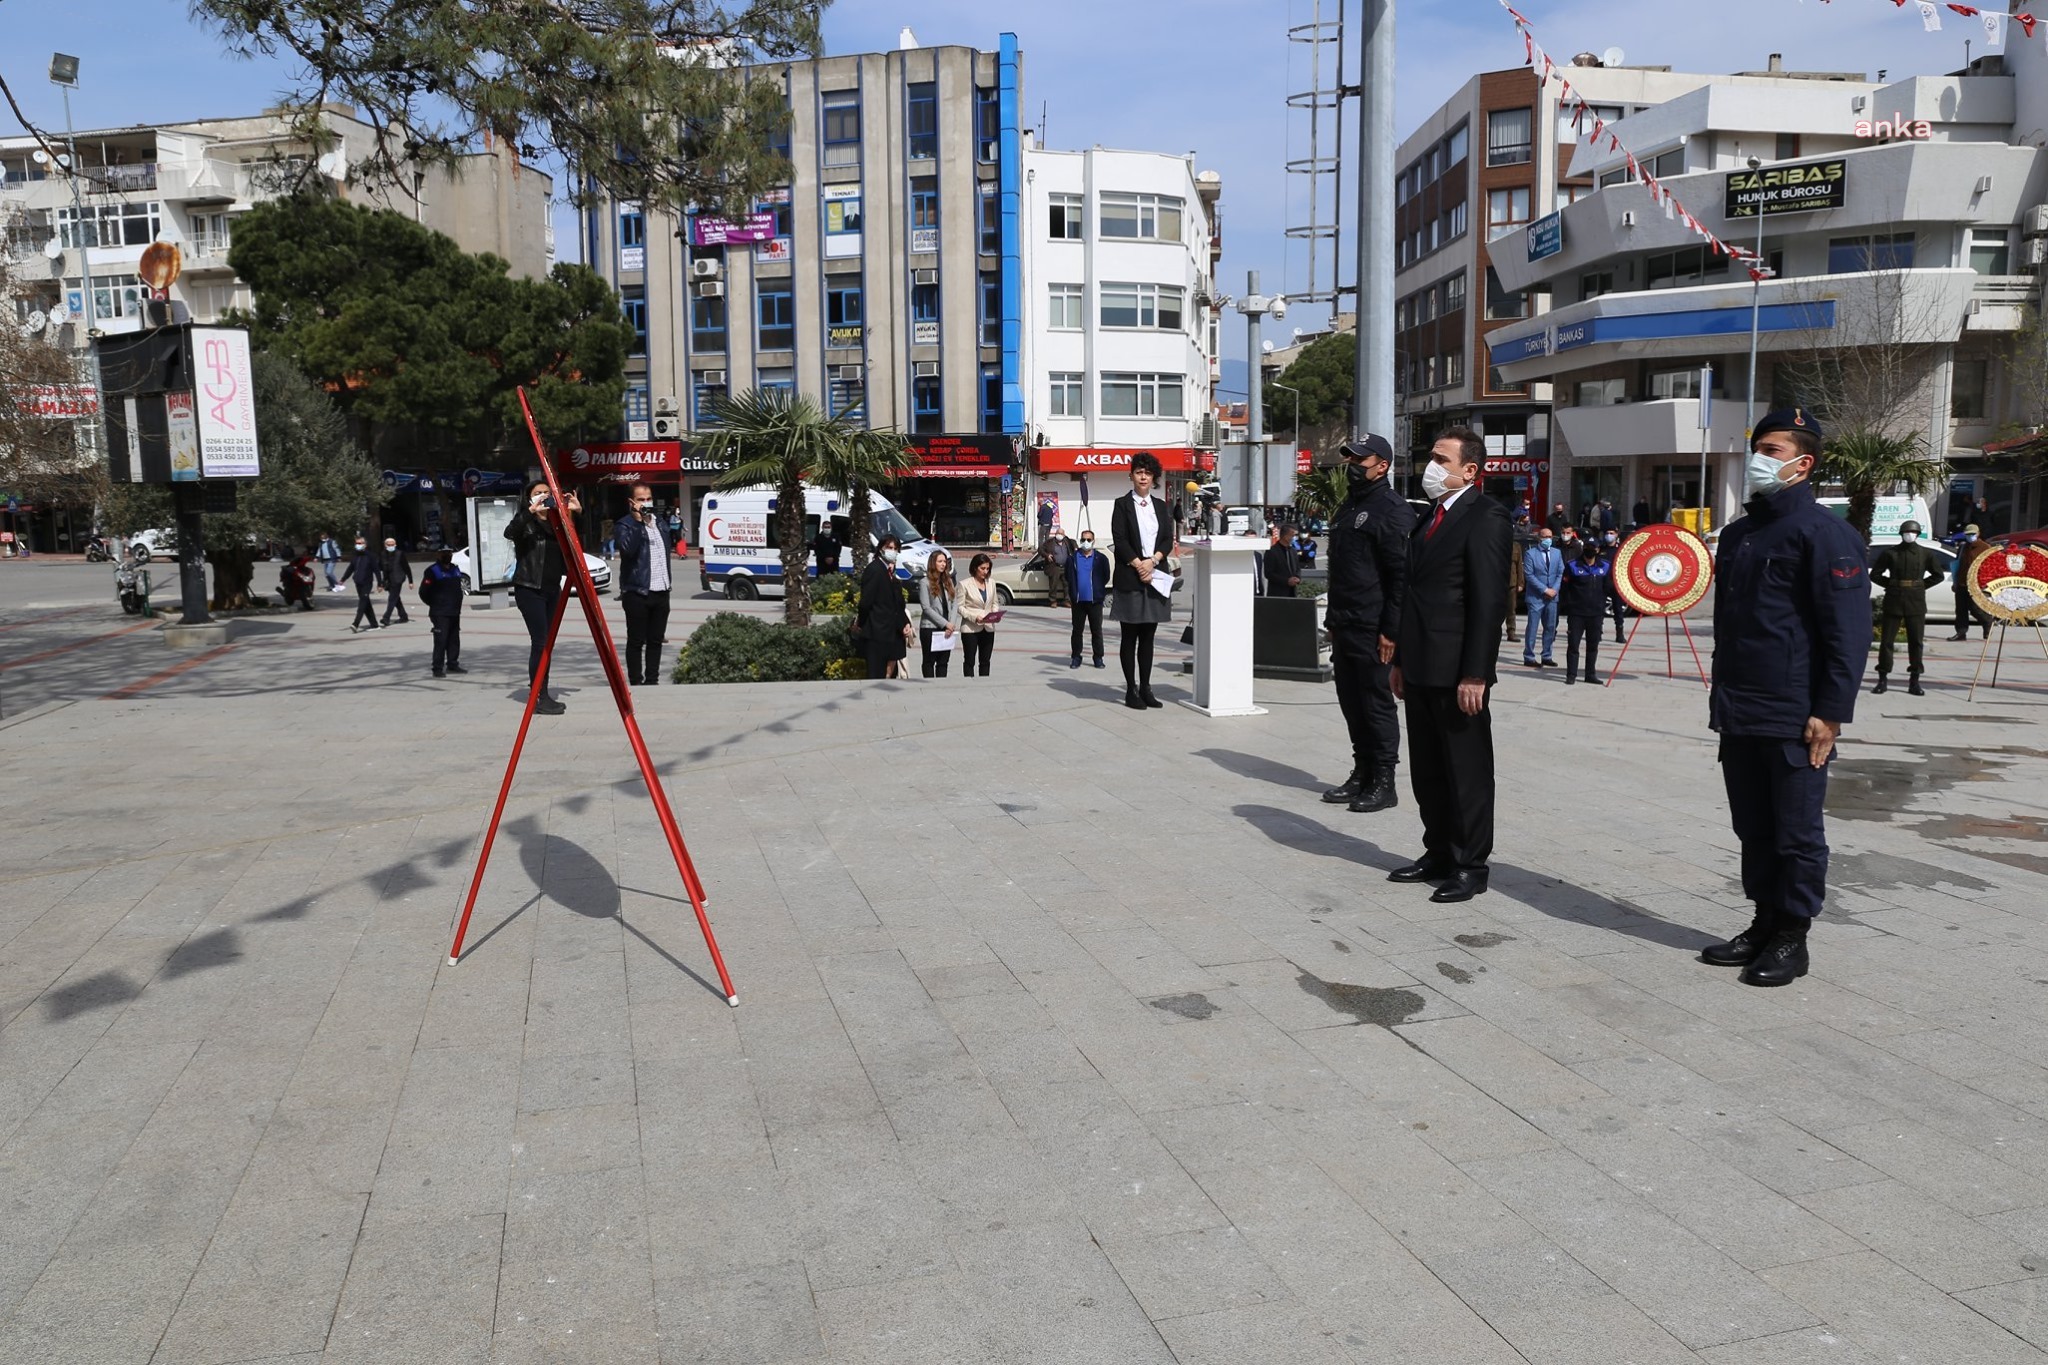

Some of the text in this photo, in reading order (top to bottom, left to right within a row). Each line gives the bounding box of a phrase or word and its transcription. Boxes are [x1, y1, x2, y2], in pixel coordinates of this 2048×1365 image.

[1729, 163, 1843, 191] SARIBAŞ
[1738, 184, 1832, 203] HUKUK BÜROSU
[1771, 202, 1799, 212] Mustafa
[764, 242, 786, 254] SOL
[832, 328, 862, 338] AVUKAT
[1558, 328, 1584, 344] BANKASI
[204, 340, 237, 430] AGB
[956, 446, 979, 454] ÇORBA
[592, 451, 666, 466] PAMUKKALE
[1074, 454, 1132, 465] AKBAN
[1484, 461, 1532, 472] czane
[714, 548, 757, 556] AMBULANS
